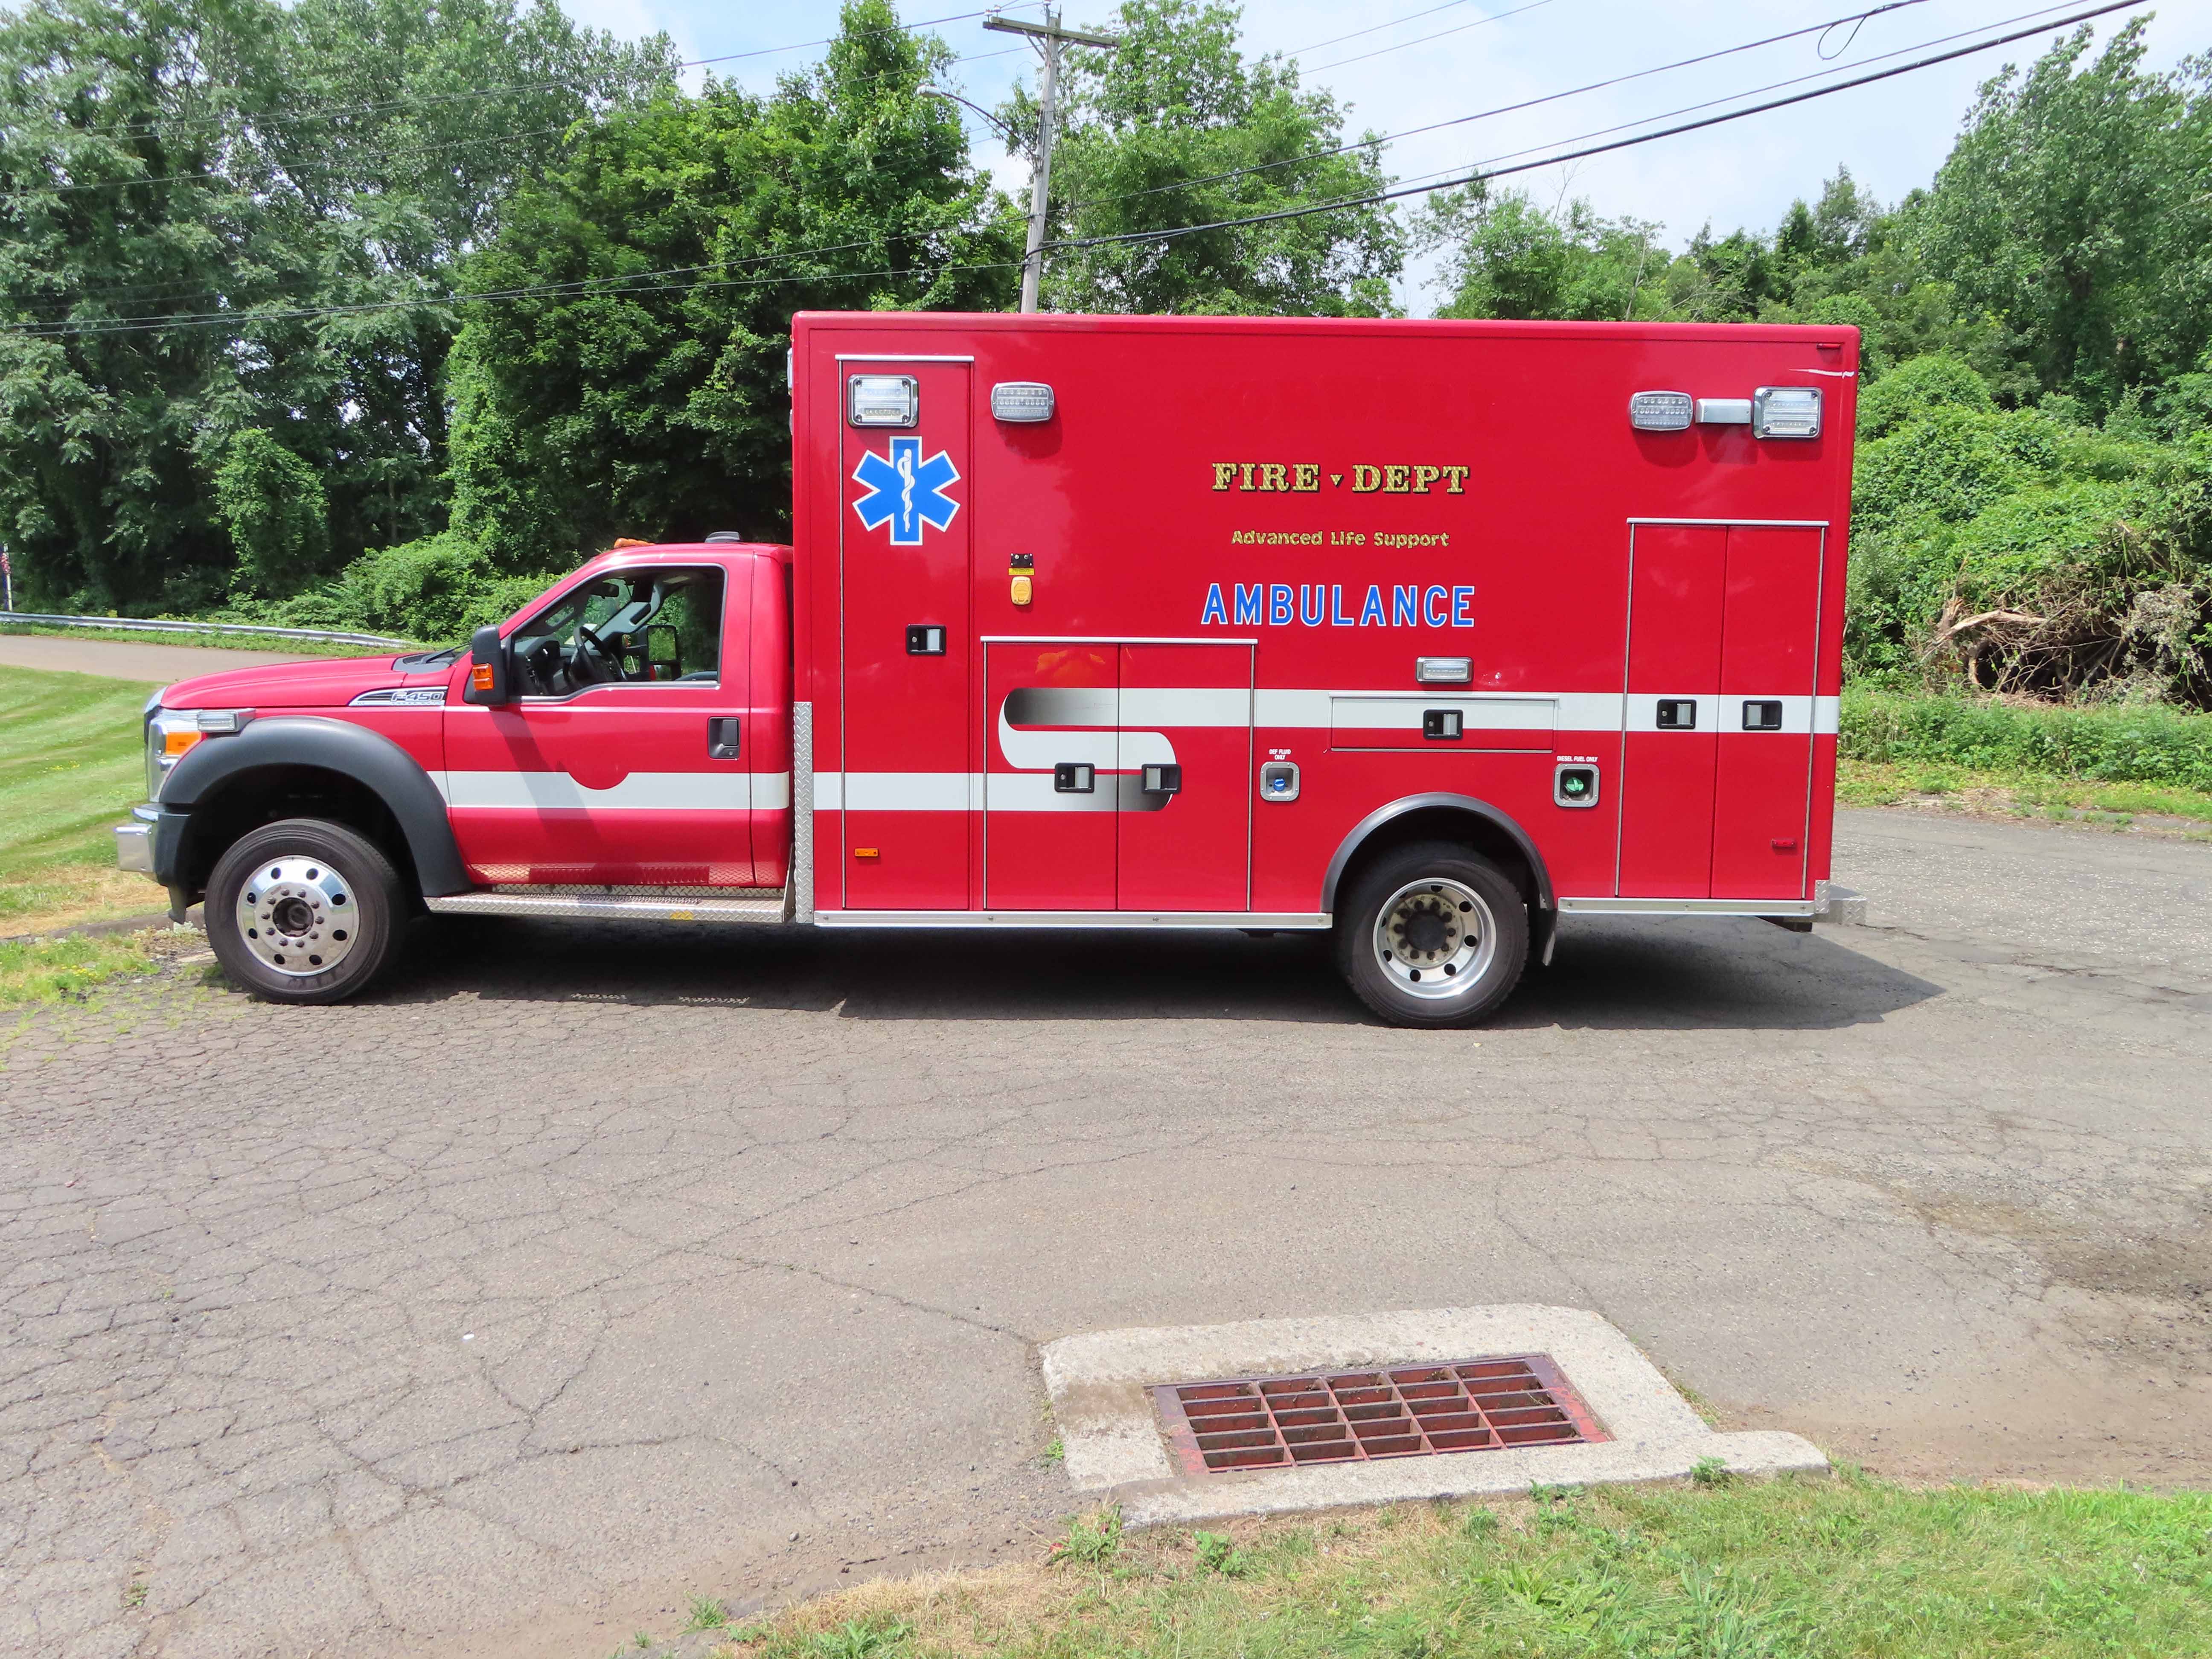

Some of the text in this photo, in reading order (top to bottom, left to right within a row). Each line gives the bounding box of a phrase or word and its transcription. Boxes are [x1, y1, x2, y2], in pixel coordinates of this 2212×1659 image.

[1212, 463, 1469, 493] FIRE DEPT
[1231, 530, 1449, 548] Advanced Life Support
[1201, 583, 1475, 627] AMBULANCE
[390, 691, 445, 702] F-450
